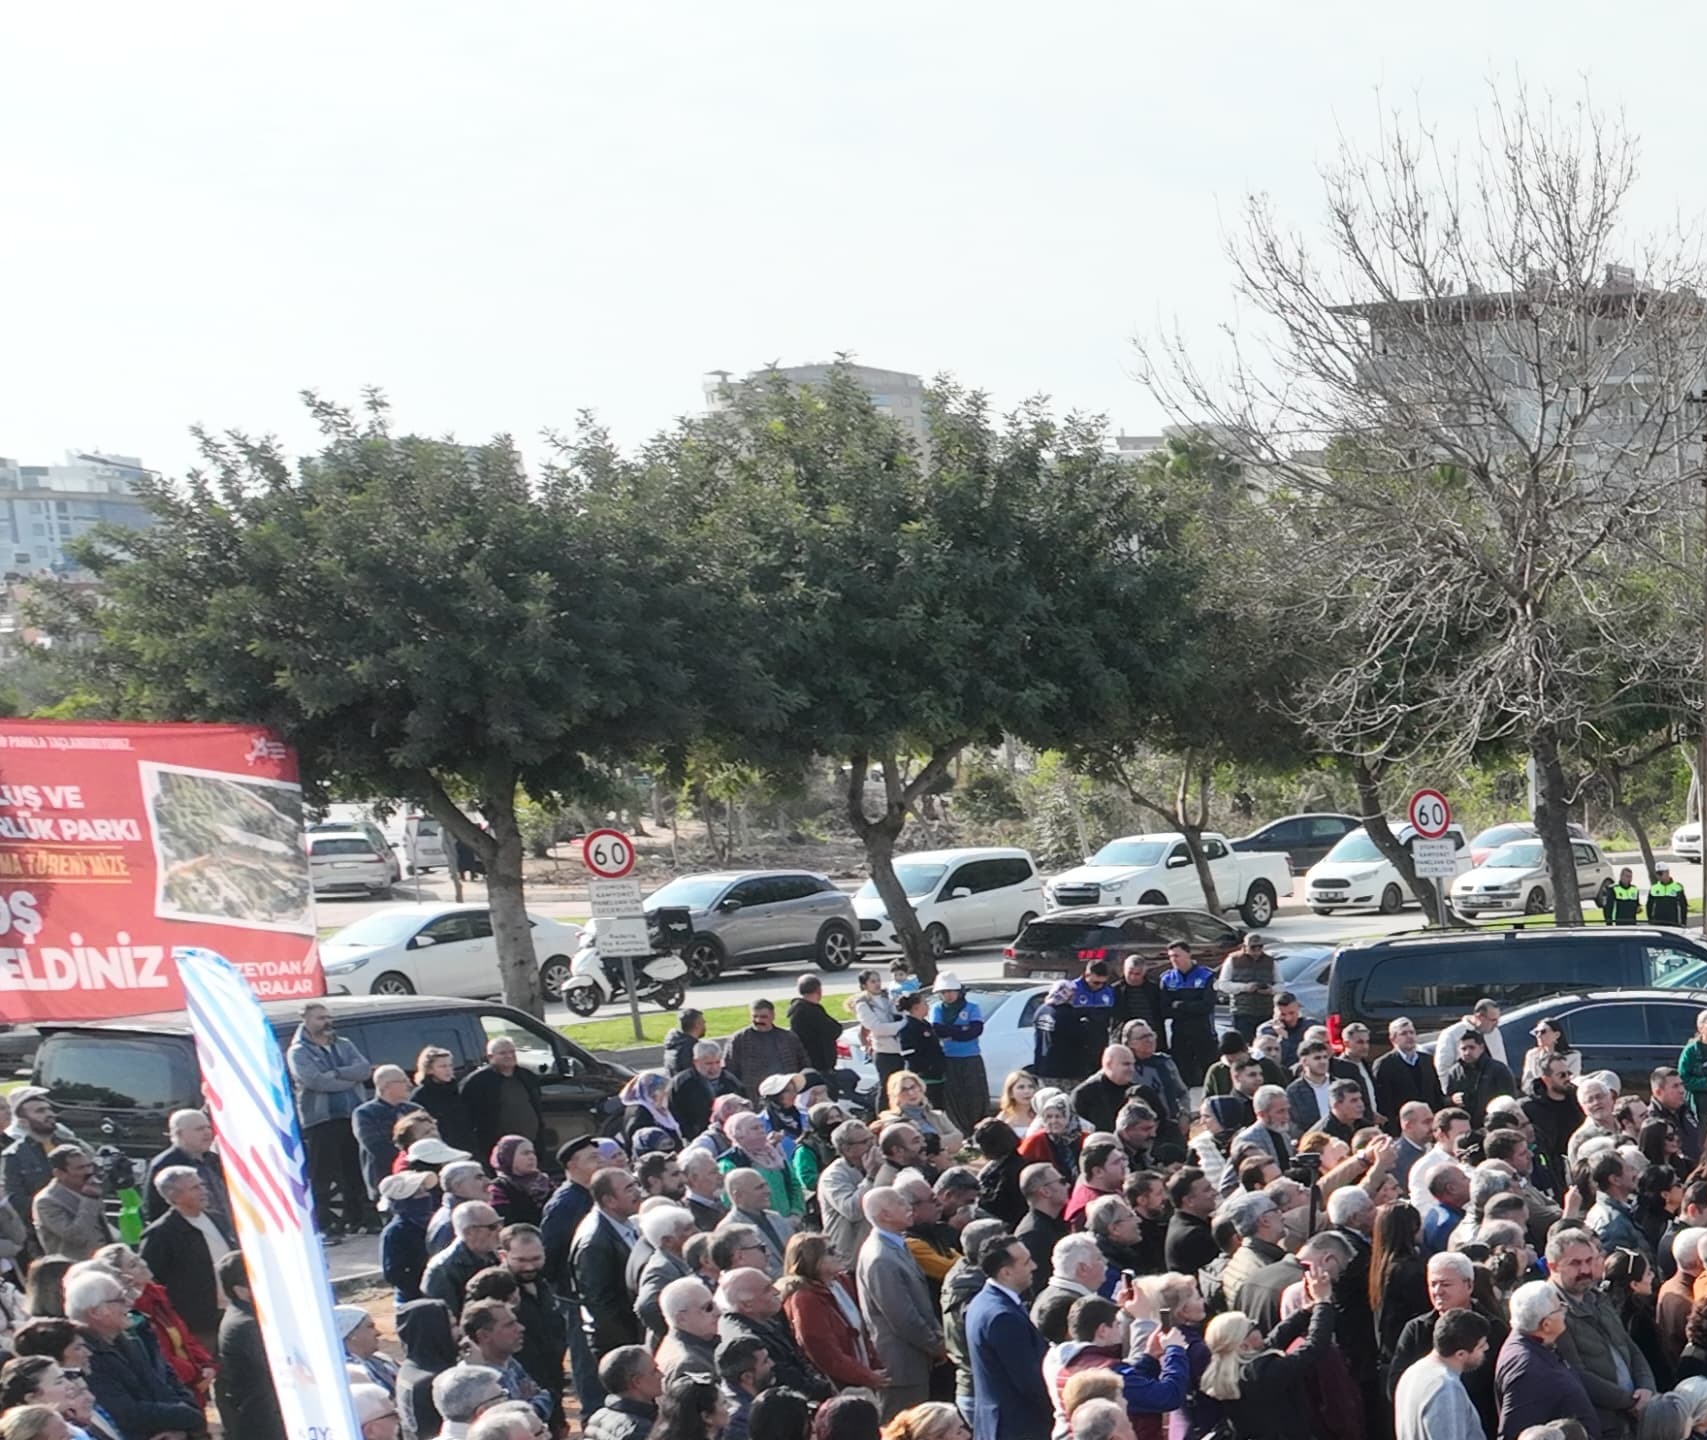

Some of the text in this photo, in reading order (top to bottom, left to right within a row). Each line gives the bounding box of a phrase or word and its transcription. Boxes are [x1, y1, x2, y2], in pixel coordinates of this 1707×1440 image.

[40, 785, 85, 808] VE
[1419, 803, 1443, 826] 60
[57, 818, 143, 841] PARKI
[594, 842, 625, 866] 60
[251, 979, 313, 996] ARALAR
